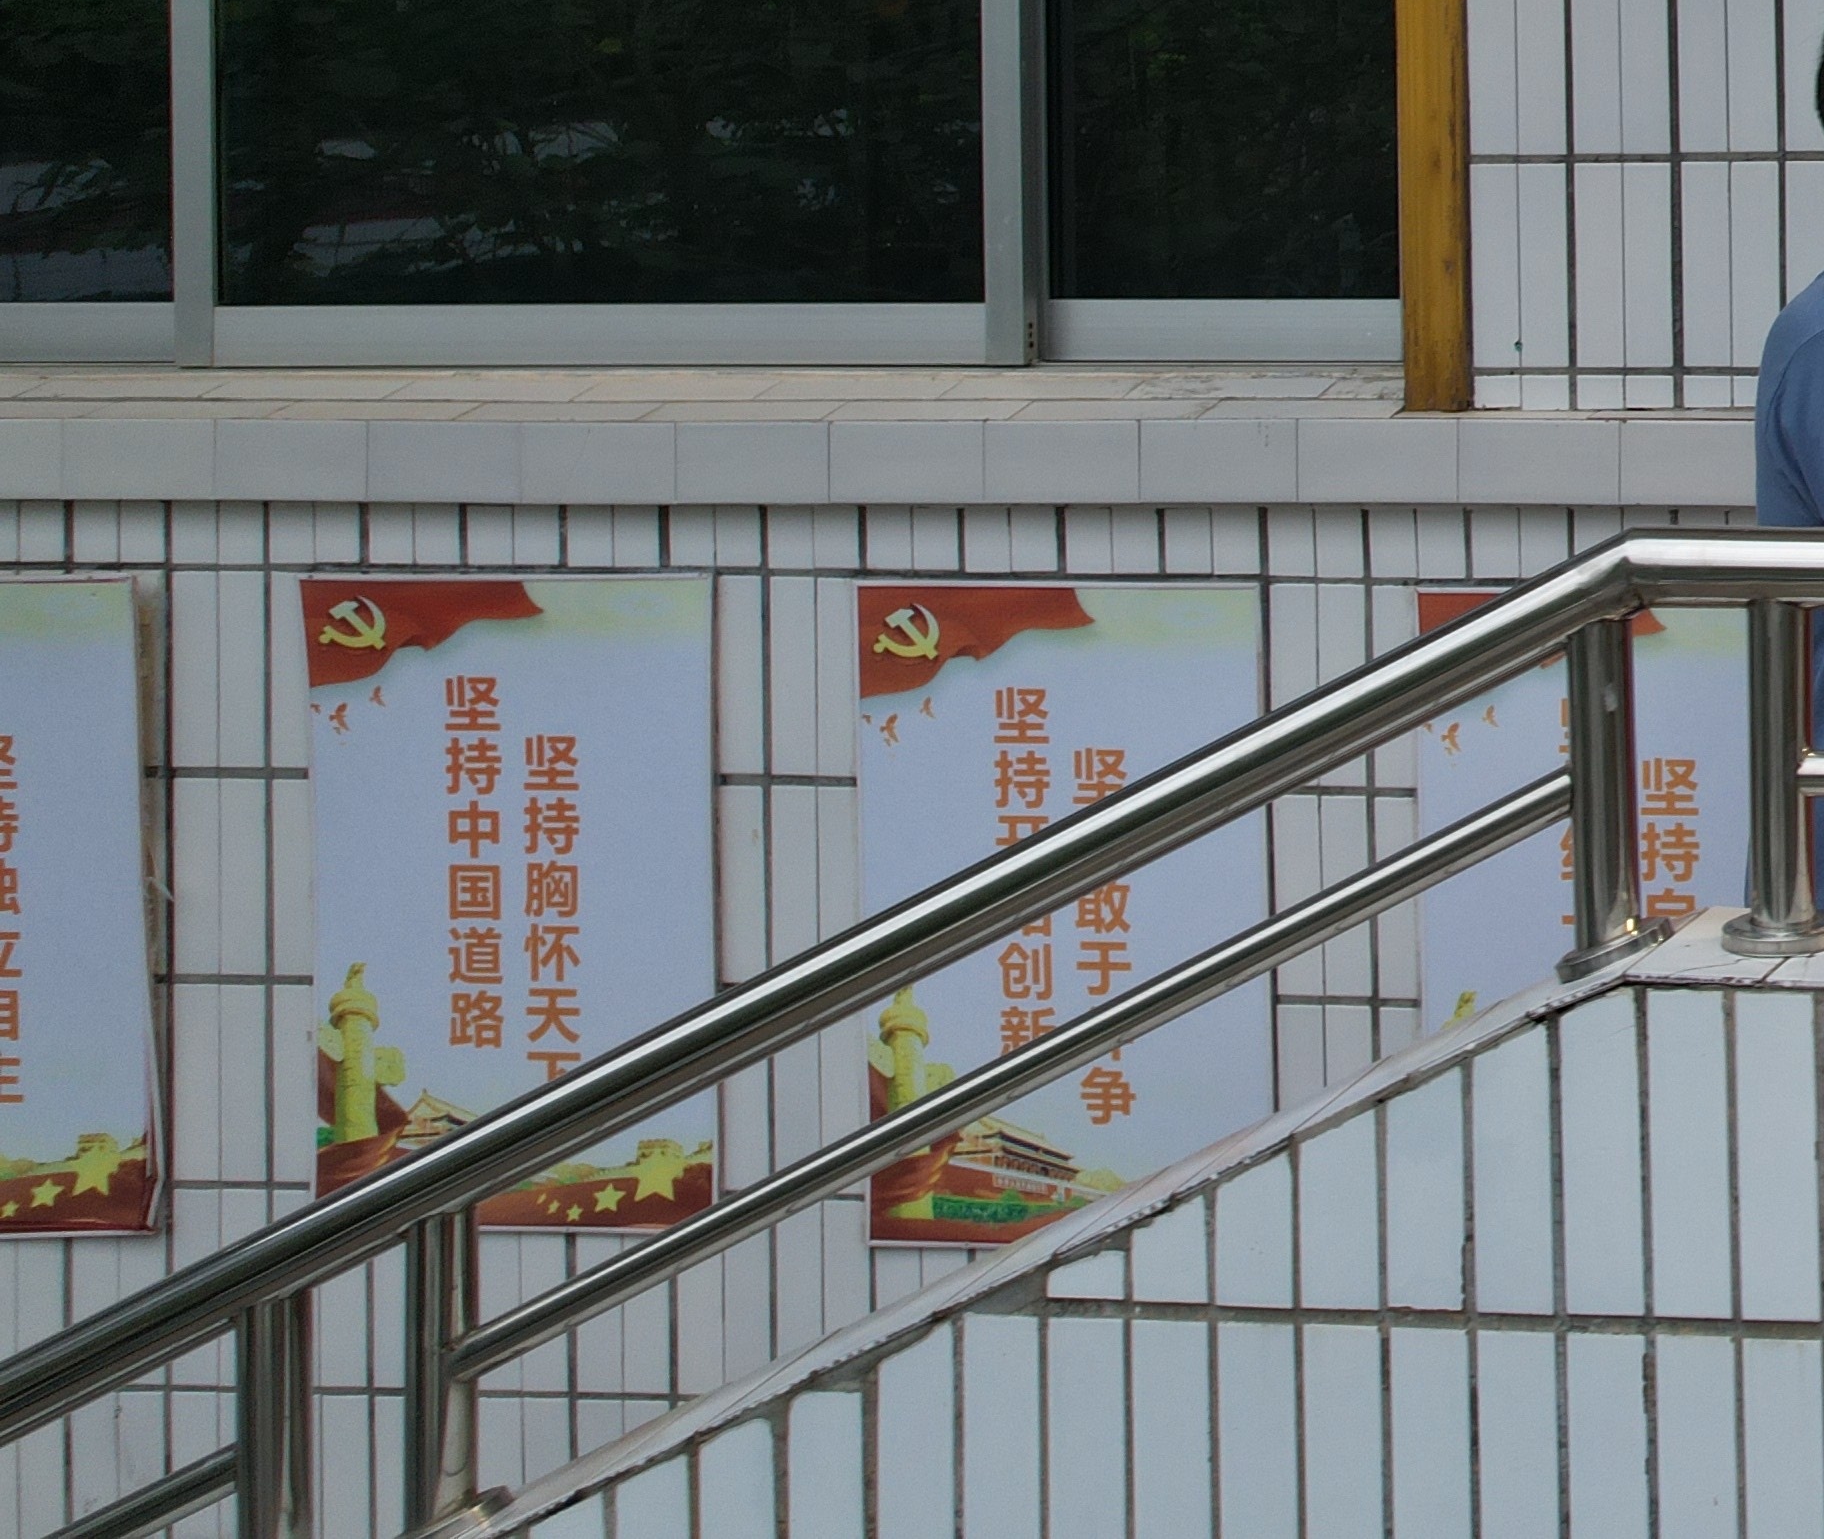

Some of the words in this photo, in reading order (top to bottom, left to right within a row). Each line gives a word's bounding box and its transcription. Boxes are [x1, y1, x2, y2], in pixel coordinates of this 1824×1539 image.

[445, 674, 504, 1049] 坚持中国道路
[523, 734, 582, 1083] 坚持胸怀天下
[993, 686, 1056, 1058] 坚持创新
[1072, 747, 1137, 1126] 坚敢于争
